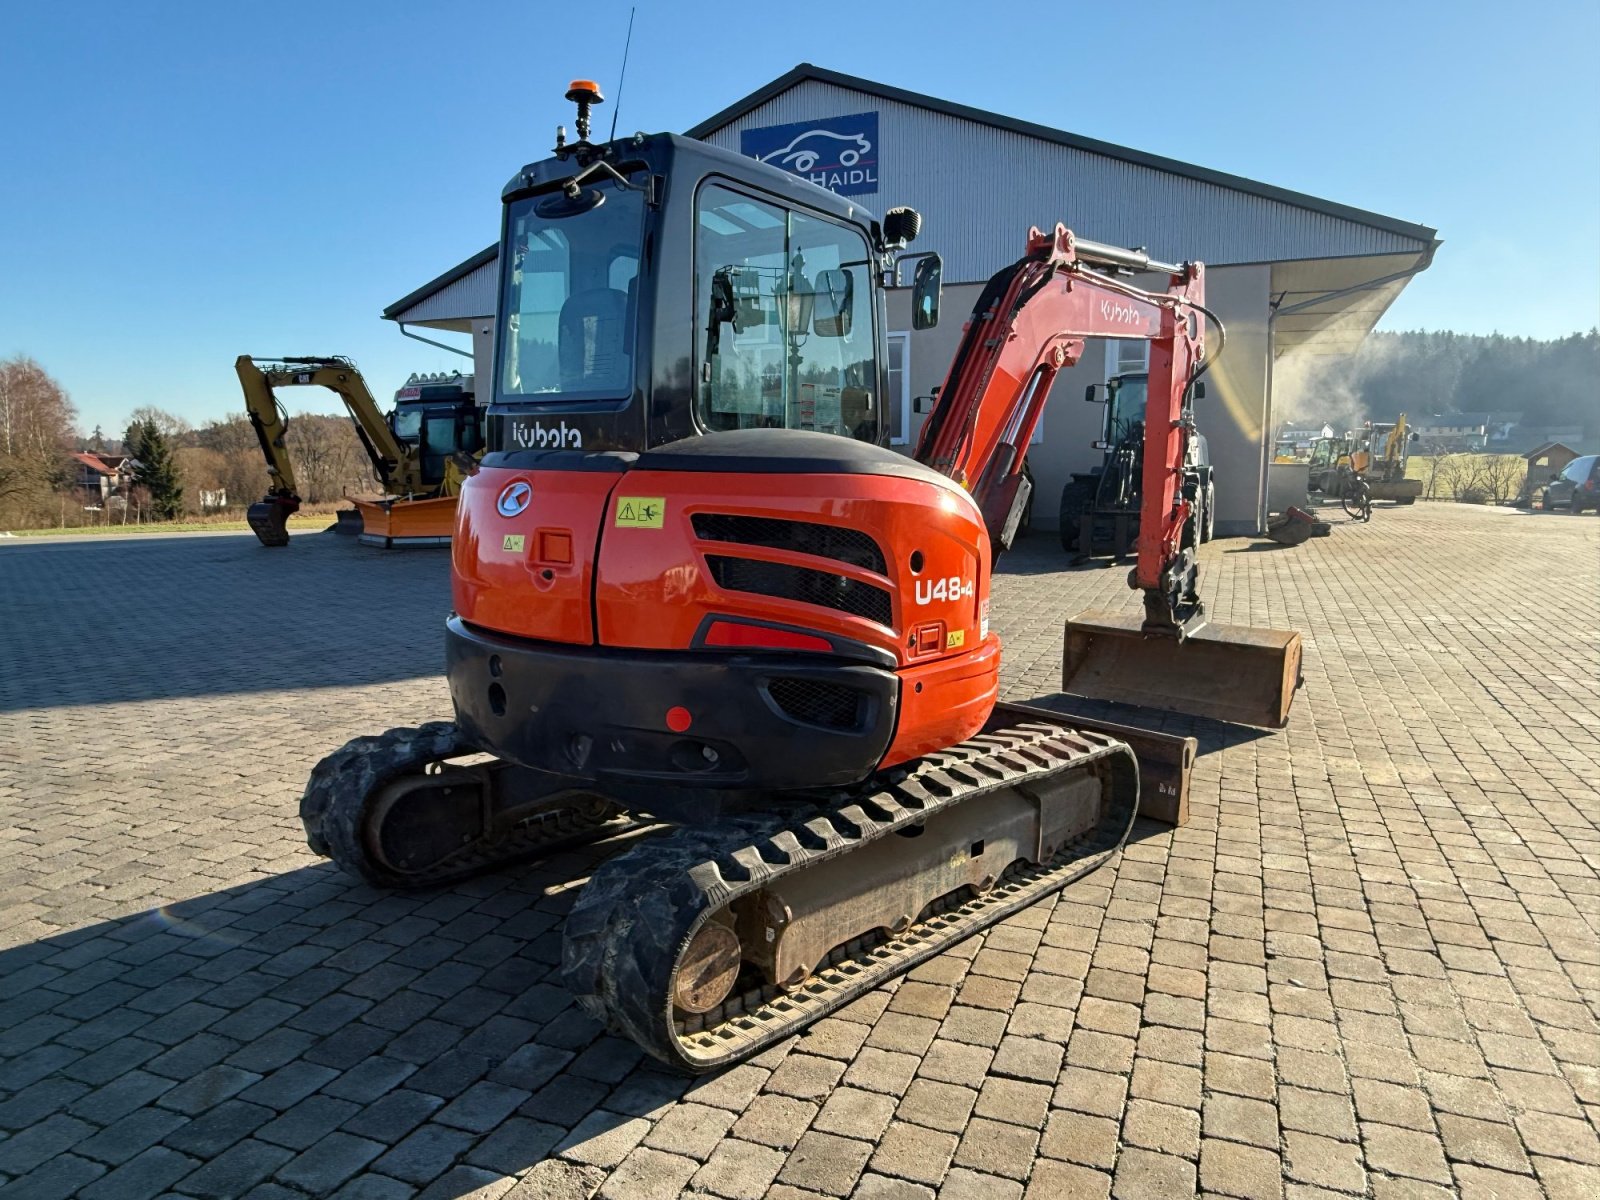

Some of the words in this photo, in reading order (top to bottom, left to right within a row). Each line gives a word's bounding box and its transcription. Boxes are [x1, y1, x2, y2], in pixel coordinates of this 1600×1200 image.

[1101, 299, 1140, 325] Kubota
[298, 374, 310, 383] CAT
[512, 420, 582, 448] Kubota
[915, 576, 973, 606] U48-4
